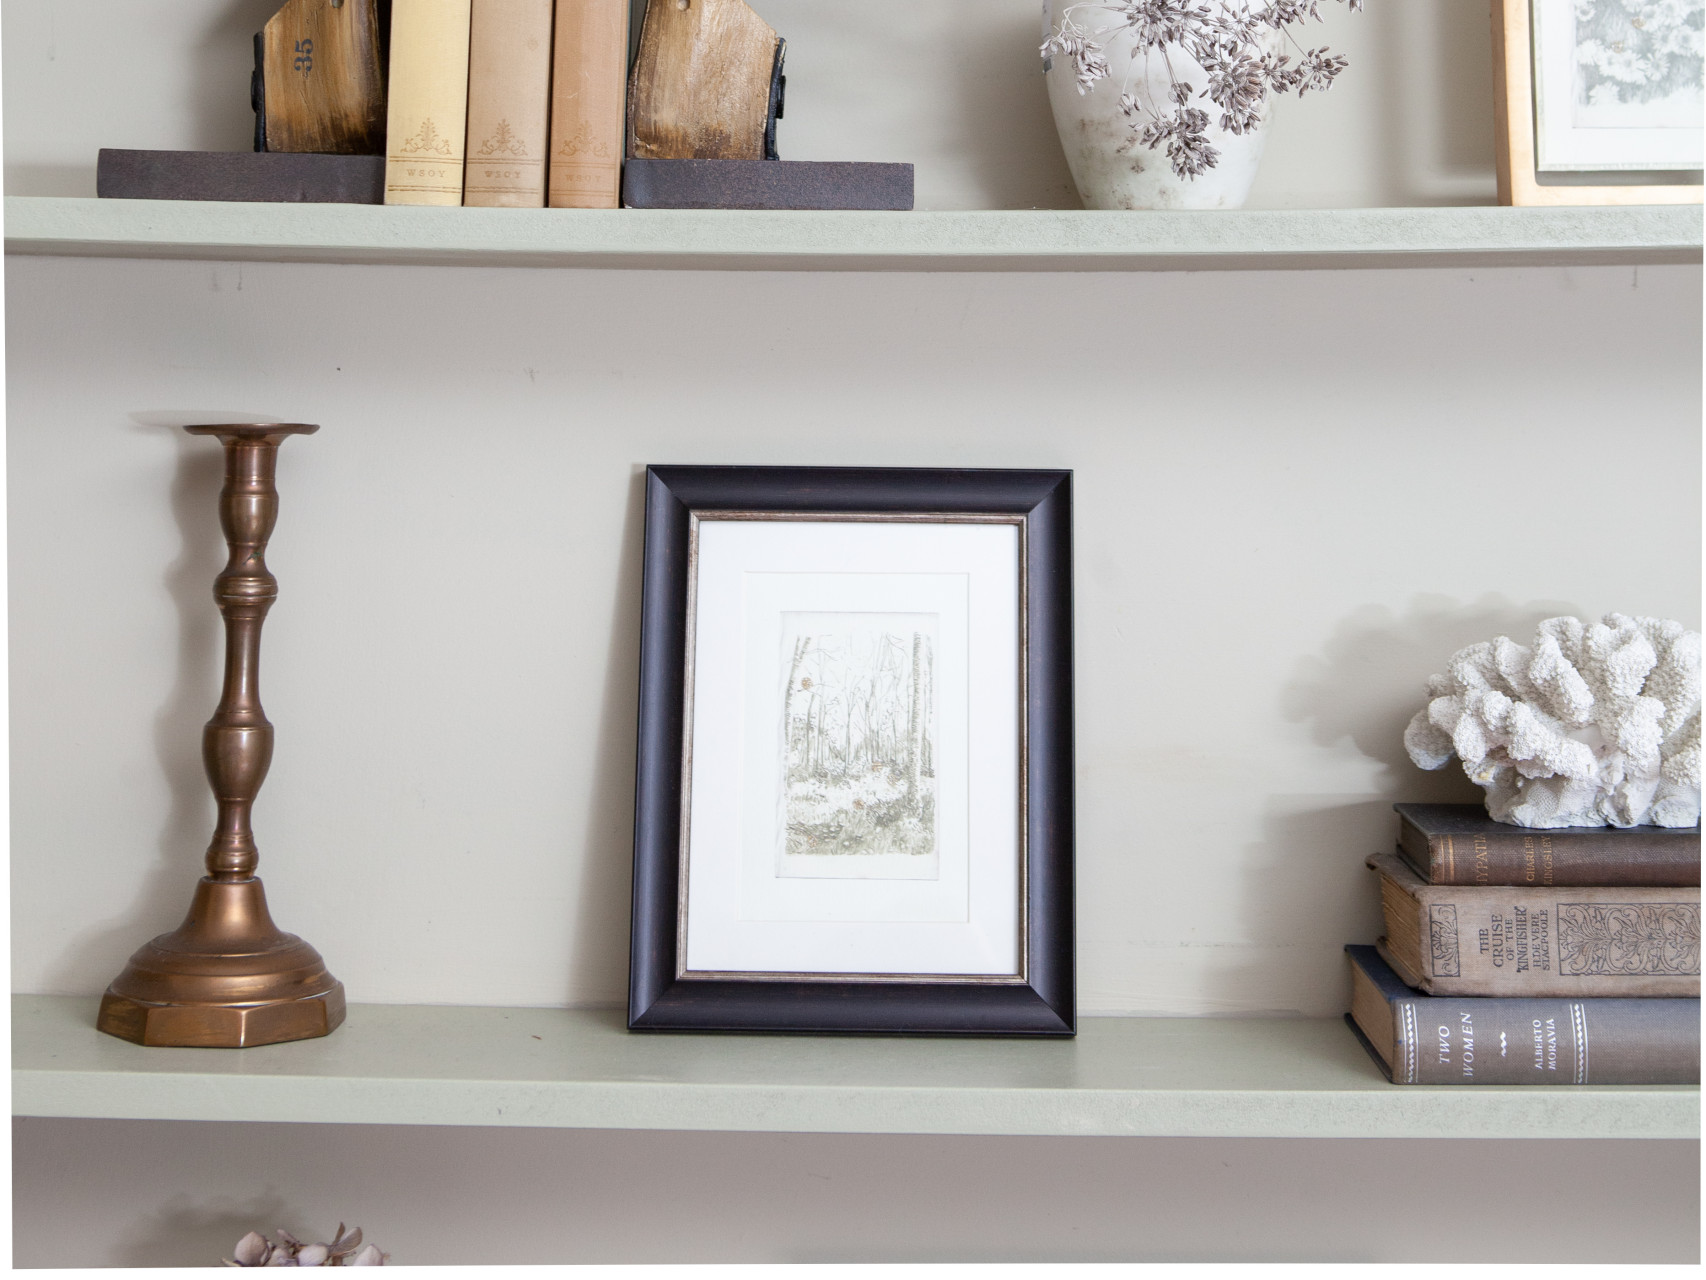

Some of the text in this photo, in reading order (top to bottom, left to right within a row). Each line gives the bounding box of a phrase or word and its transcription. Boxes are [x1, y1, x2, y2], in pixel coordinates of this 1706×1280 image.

[294, 38, 314, 72] 35
[407, 169, 446, 178] WSOY
[1524, 836, 1536, 882] CHARLES
[1541, 835, 1553, 885] KINGSLEY
[1479, 928, 1489, 954] THE
[1491, 914, 1504, 968] CRUISE
[1505, 919, 1515, 961] OF THE
[1531, 913, 1540, 941] VERE
[1540, 909, 1550, 971] STACPOOLE
[1438, 1025, 1450, 1064] TWO
[1460, 1012, 1474, 1077] WOMEN
[1532, 1019, 1543, 1070] ALBERTO
[1545, 1018, 1557, 1070] MORAVIA
